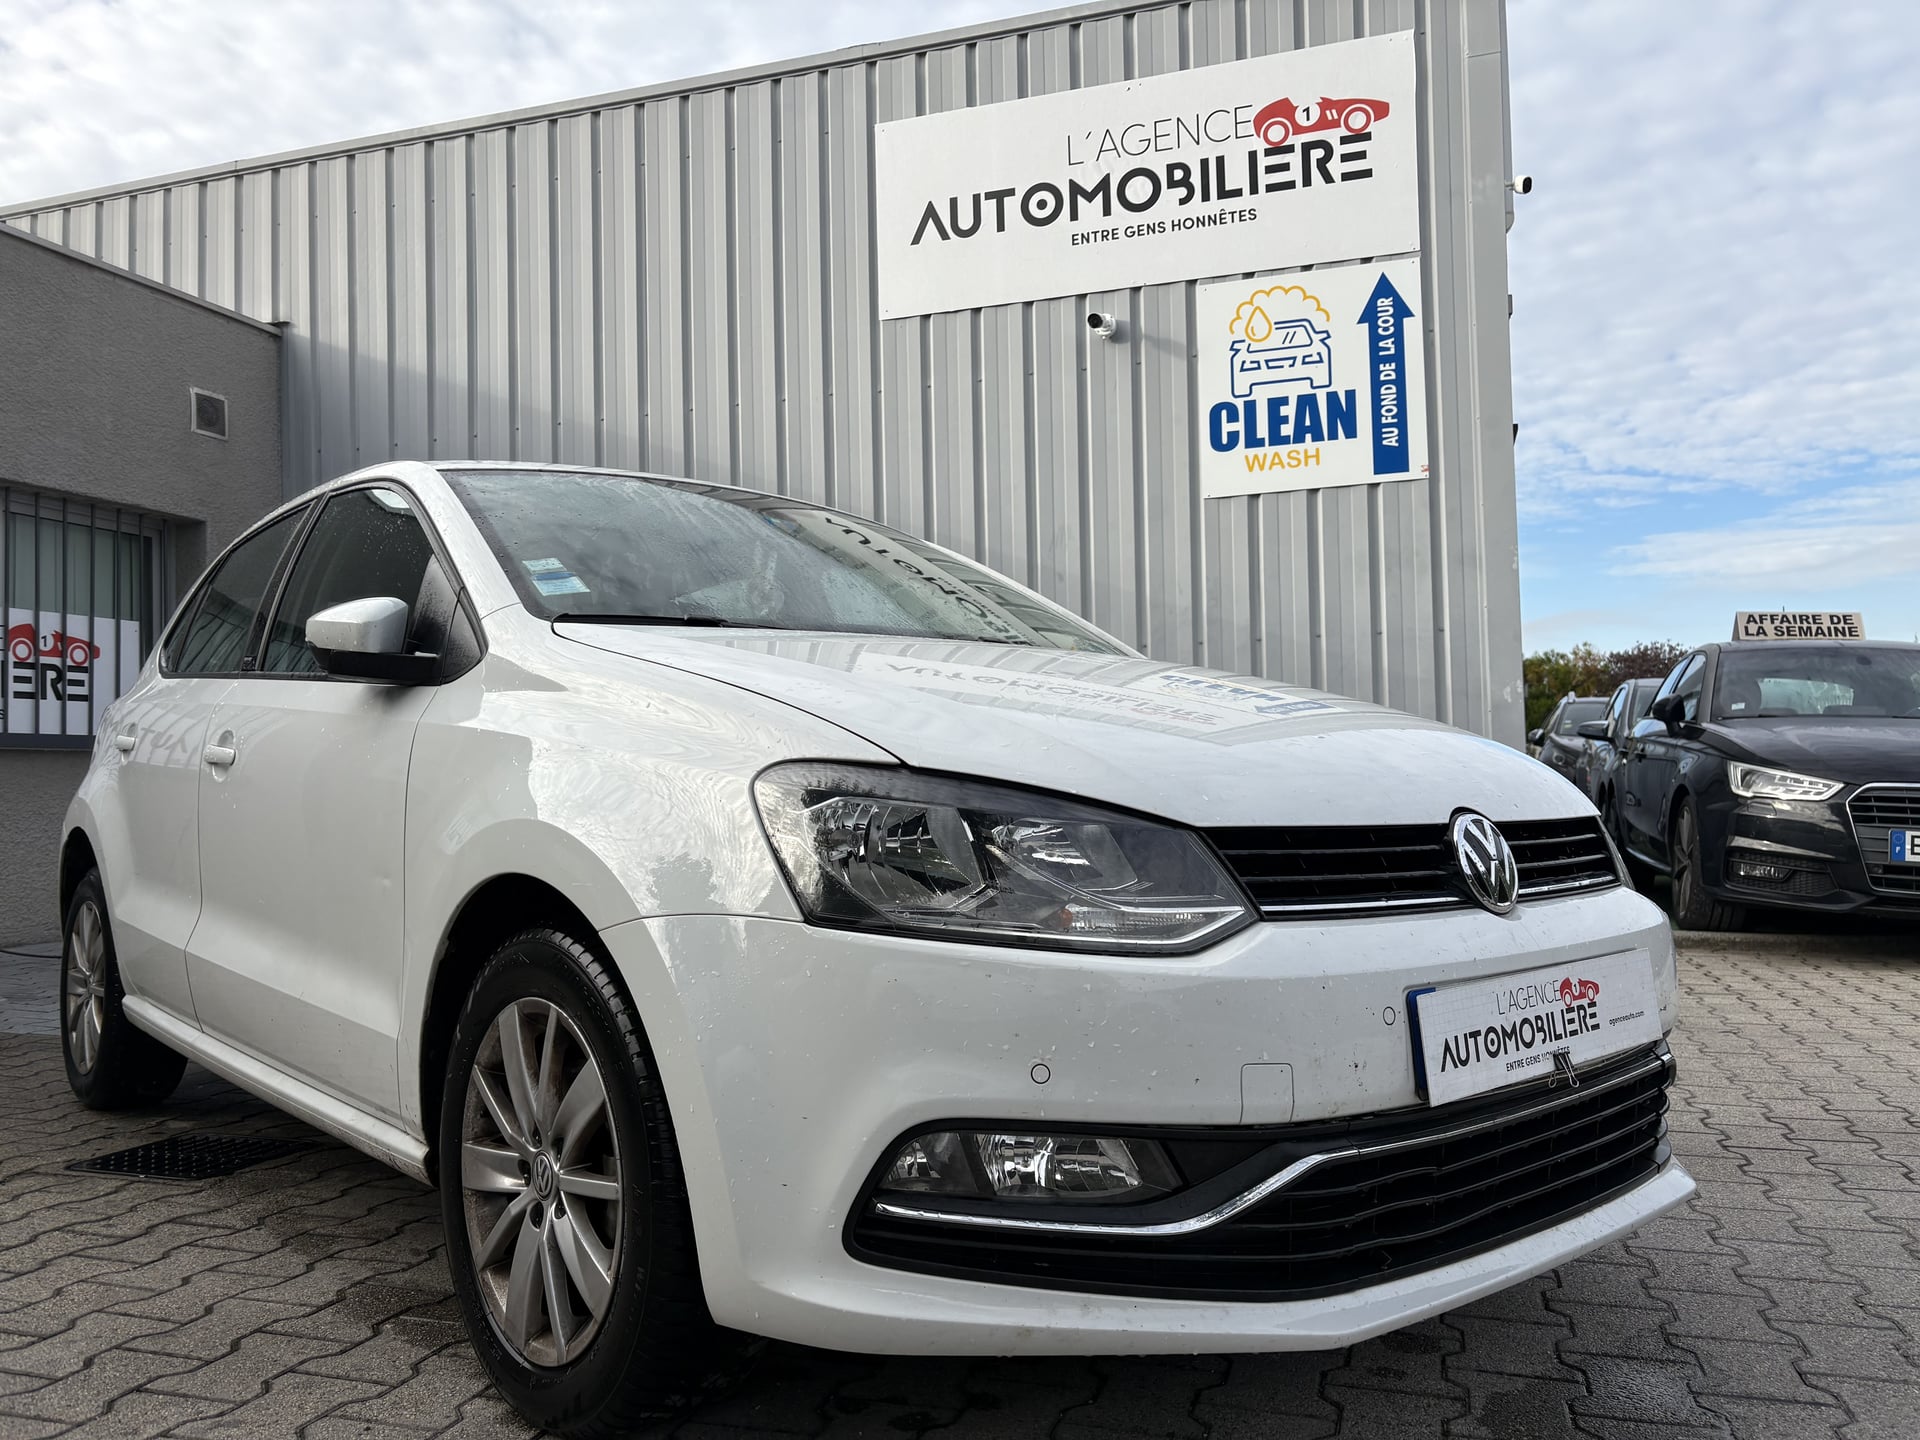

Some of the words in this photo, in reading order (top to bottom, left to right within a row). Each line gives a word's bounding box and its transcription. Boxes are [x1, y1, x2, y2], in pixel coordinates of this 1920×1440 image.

[1301, 105, 1313, 123] 1
[1066, 103, 1254, 166] L'AGENCE
[1071, 226, 1120, 246] ENTRE
[1124, 221, 1167, 238] GENS
[1171, 208, 1258, 231] HONNÊTES
[1377, 296, 1395, 332] COUR
[1379, 337, 1395, 356] LA
[1379, 361, 1396, 380] DE
[1381, 384, 1398, 424] FOND
[1208, 389, 1358, 453] CLEAN
[1382, 426, 1400, 447] AU
[1244, 447, 1321, 473] WASH
[1745, 614, 1823, 625] AFFAIRE
[1828, 614, 1854, 625] DE
[1744, 625, 1768, 637] LA
[1774, 625, 1859, 637] SEMAINE
[41, 635, 48, 648] 1
[1497, 979, 1560, 1015] L'AGENCE
[1608, 1010, 1645, 1027] agenceauto.com
[1506, 1058, 1525, 1072] ENTRE
[1525, 1054, 1541, 1067] GENS
